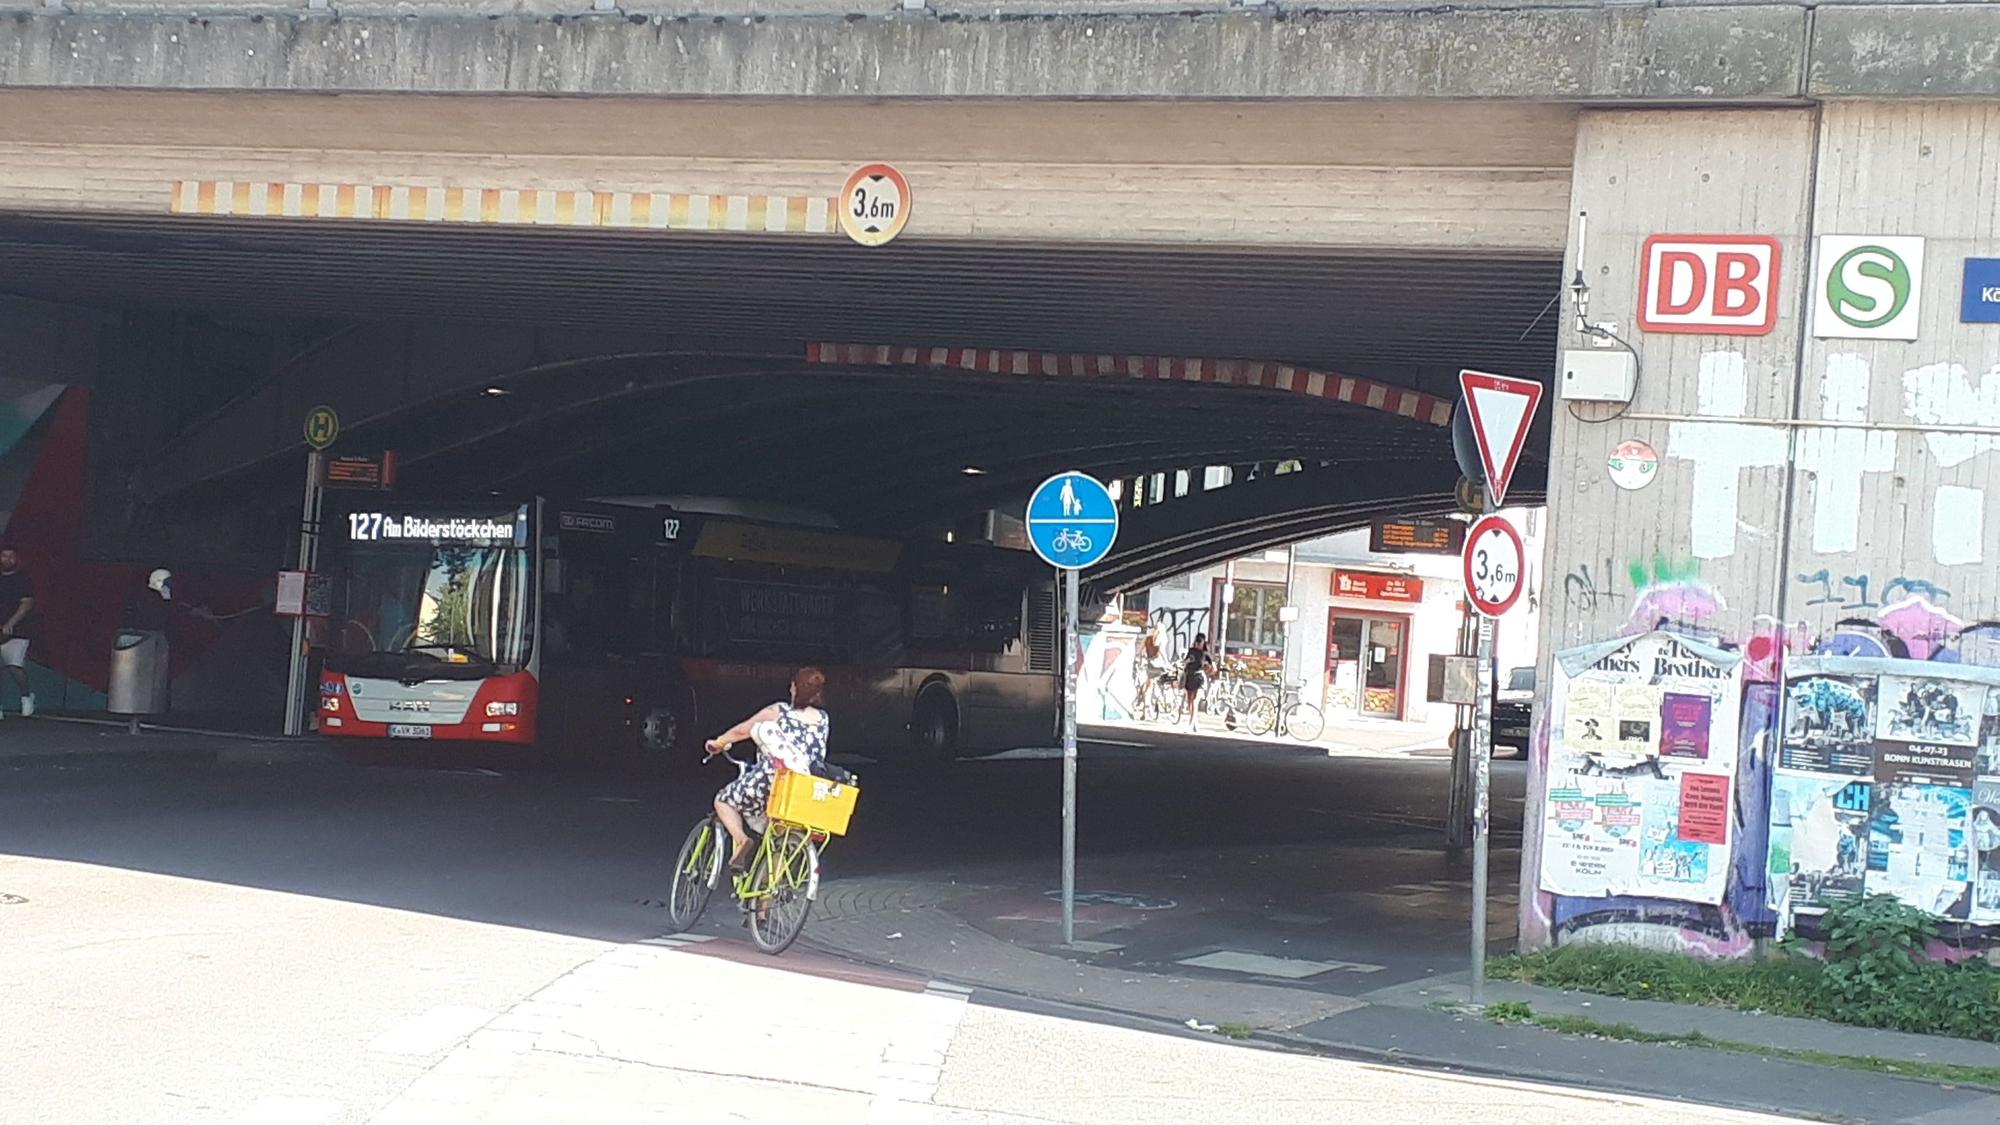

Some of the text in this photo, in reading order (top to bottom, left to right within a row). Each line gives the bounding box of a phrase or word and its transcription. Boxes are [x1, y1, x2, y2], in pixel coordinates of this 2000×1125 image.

[1656, 251, 1761, 317] DB
[1838, 251, 1896, 323] S
[313, 414, 330, 438] H
[348, 512, 513, 540] 127 Am Bilderstöckchen
[663, 518, 680, 539] 127
[1654, 657, 1733, 680] Brothers
[1884, 753, 1911, 764] BONN
[1908, 744, 1949, 757] 04.07.23
